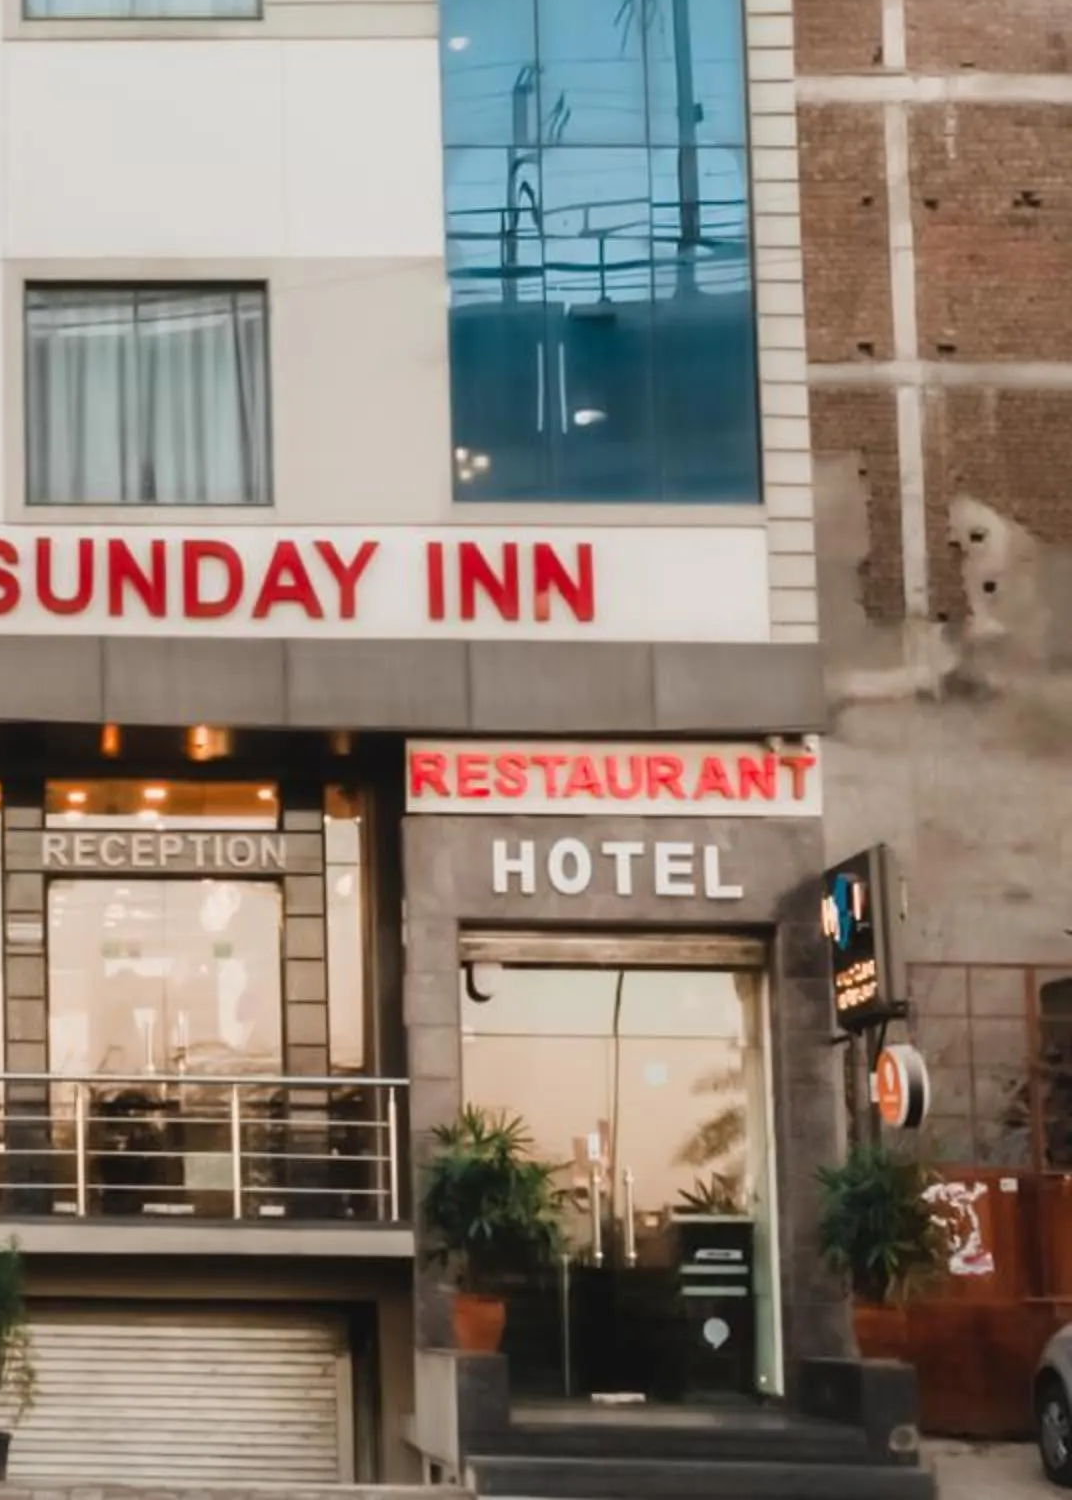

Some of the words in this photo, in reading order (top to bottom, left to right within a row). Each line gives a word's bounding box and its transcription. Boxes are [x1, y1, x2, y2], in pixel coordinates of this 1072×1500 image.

[427, 542, 595, 622] INN
[409, 749, 817, 800] RESTAURANT
[41, 832, 287, 868] RECEPTION
[492, 837, 744, 899] HOTEL
